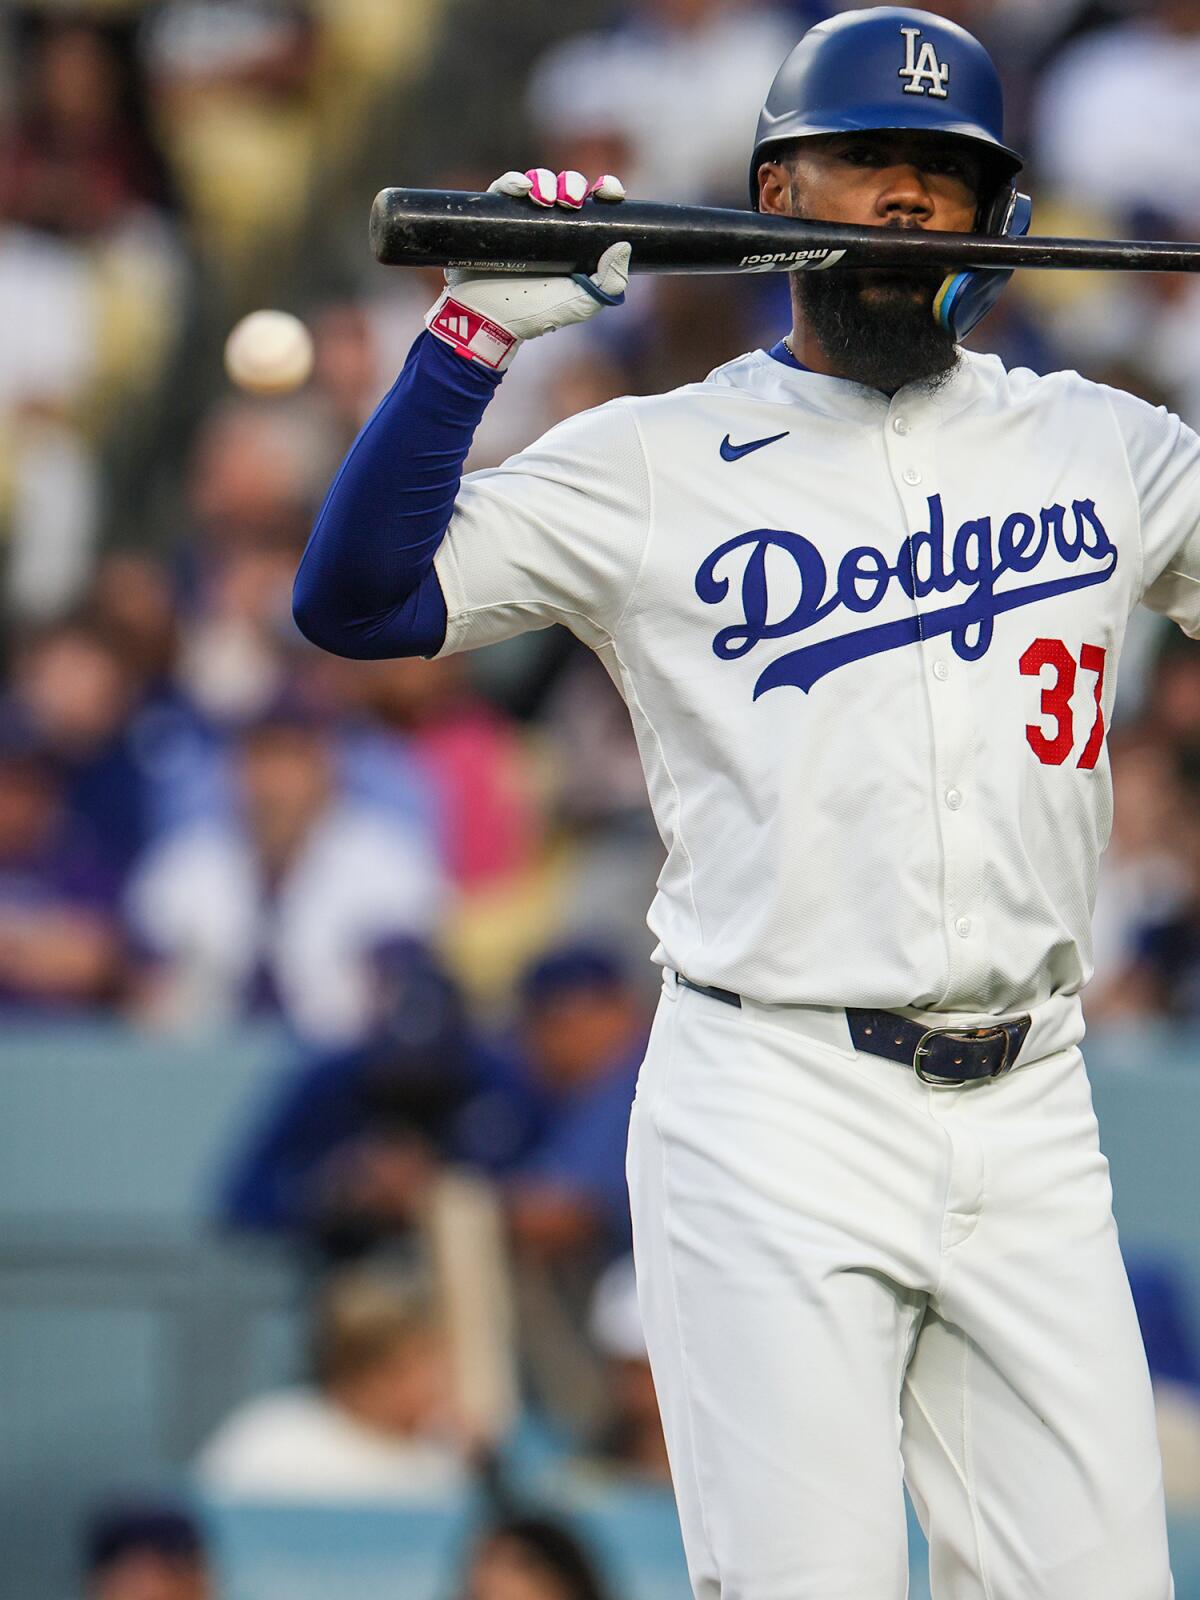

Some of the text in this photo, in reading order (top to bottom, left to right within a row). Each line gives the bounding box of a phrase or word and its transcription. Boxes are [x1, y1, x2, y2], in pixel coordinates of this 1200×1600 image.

[898, 27, 949, 98] LA
[738, 248, 829, 267] marucci
[694, 493, 1118, 702] Dodgers
[1018, 638, 1107, 770] 37
